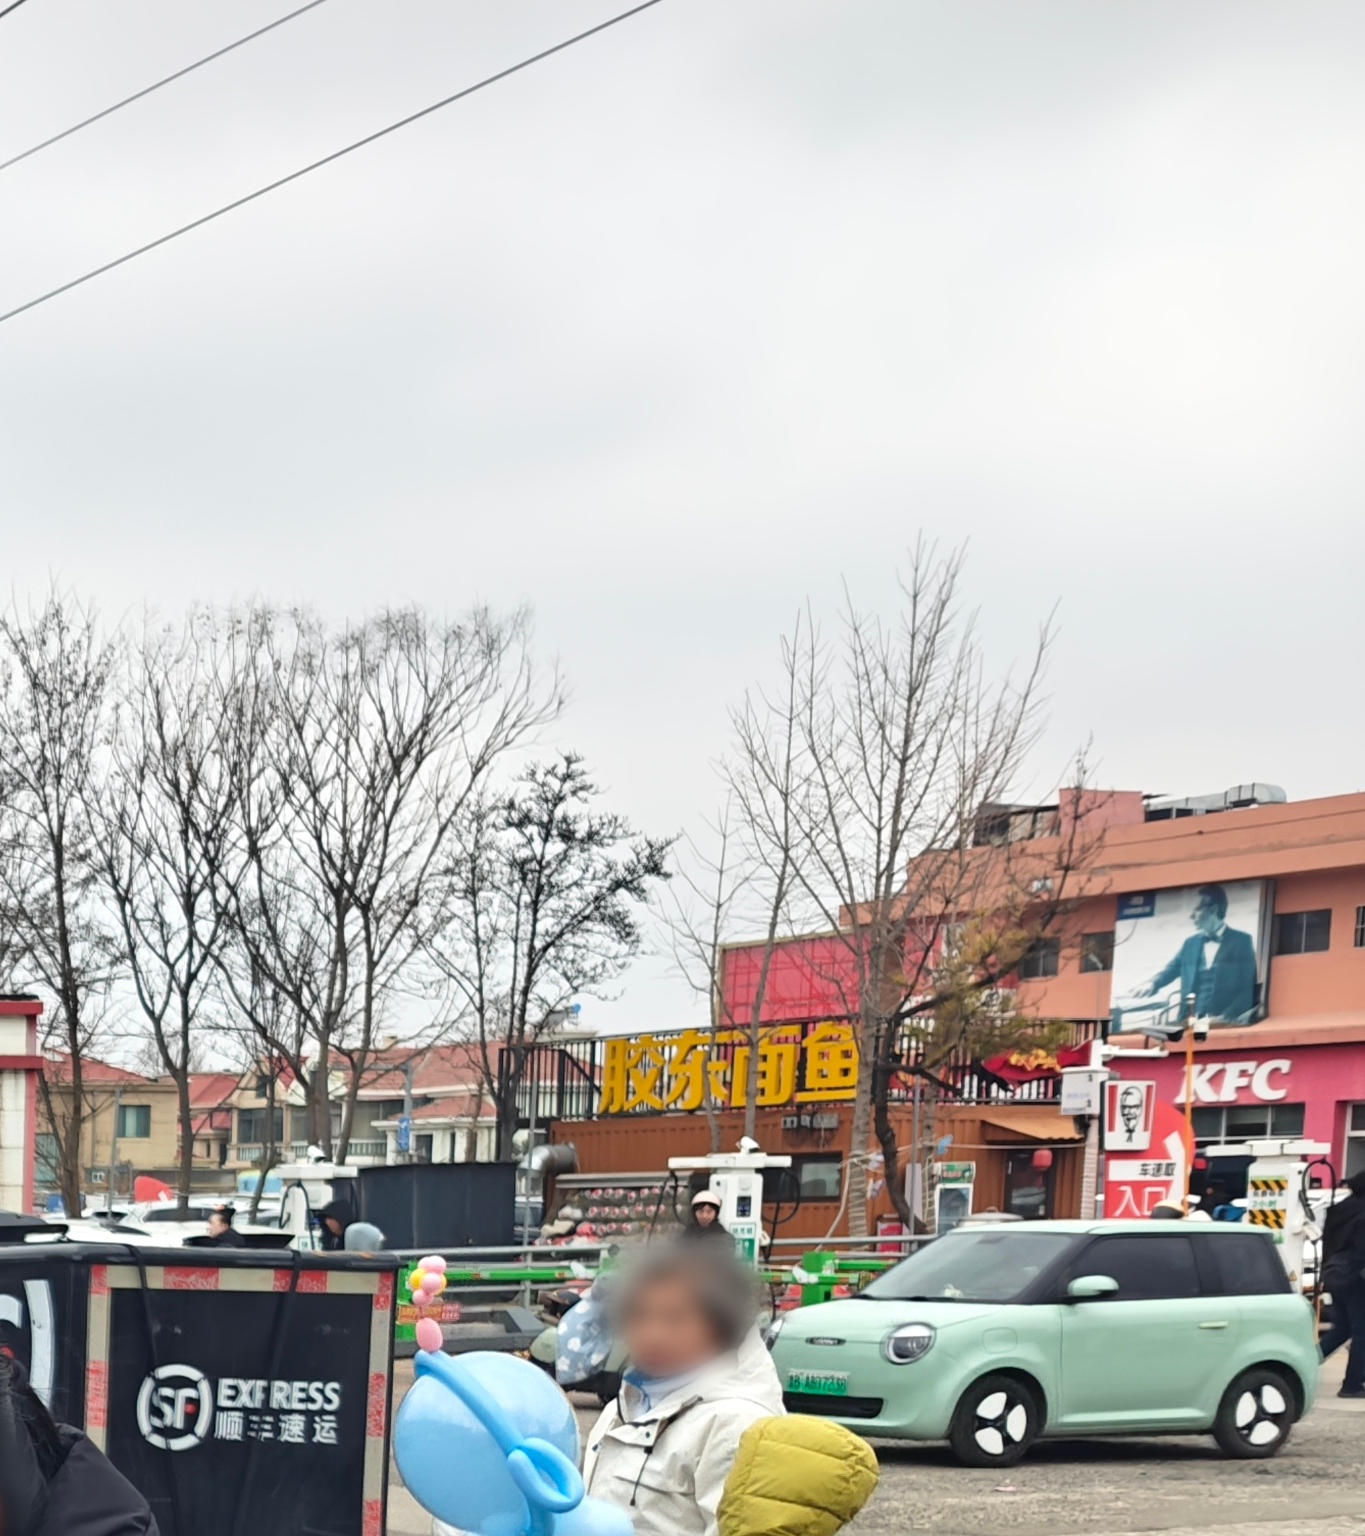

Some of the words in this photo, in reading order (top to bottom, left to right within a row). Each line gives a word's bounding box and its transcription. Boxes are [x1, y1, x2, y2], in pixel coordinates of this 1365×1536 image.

[598, 1021, 859, 1114] 胶东面鱼
[1173, 1059, 1292, 1104] KFC
[1113, 1185, 1167, 1217] 入口
